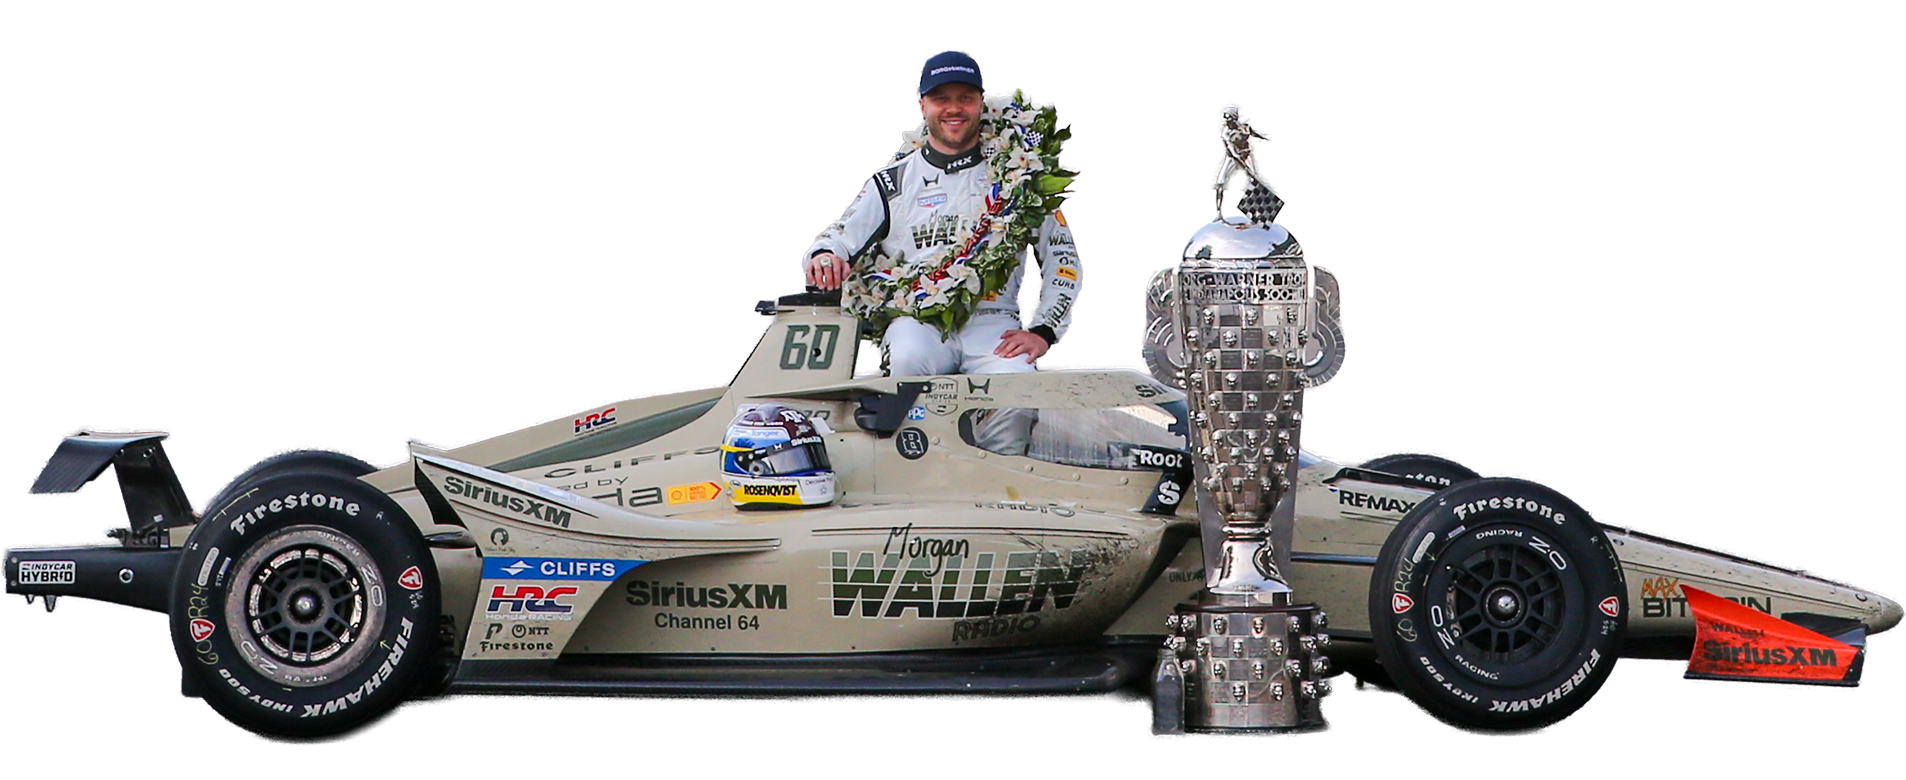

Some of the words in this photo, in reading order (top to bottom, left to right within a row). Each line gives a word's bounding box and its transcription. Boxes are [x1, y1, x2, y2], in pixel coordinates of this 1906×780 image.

[780, 324, 840, 369] 60
[574, 407, 616, 433] HRC
[444, 476, 572, 529] SiriusXM
[743, 484, 797, 496] ROSENQVIST
[1339, 490, 1417, 513] REMAX
[230, 491, 361, 535] Firestone
[1453, 496, 1566, 525] Firestone
[883, 522, 969, 577] Morgan
[21, 571, 73, 582] HYBRID
[540, 560, 616, 577] CLIFFS
[626, 580, 788, 610] SiriusXM
[830, 549, 1088, 619] WALLEN
[486, 585, 580, 613] HRC
[528, 627, 550, 636] NTT
[654, 612, 732, 631] Channel
[738, 615, 760, 630] 64
[952, 614, 1041, 642] RADIO
[479, 641, 553, 653] Firestone
[1703, 640, 1837, 667] SiriusXM
[300, 616, 415, 718] FIREHAWK
[1455, 654, 1499, 680] RACING
[1488, 648, 1601, 713] FIREHAWK
